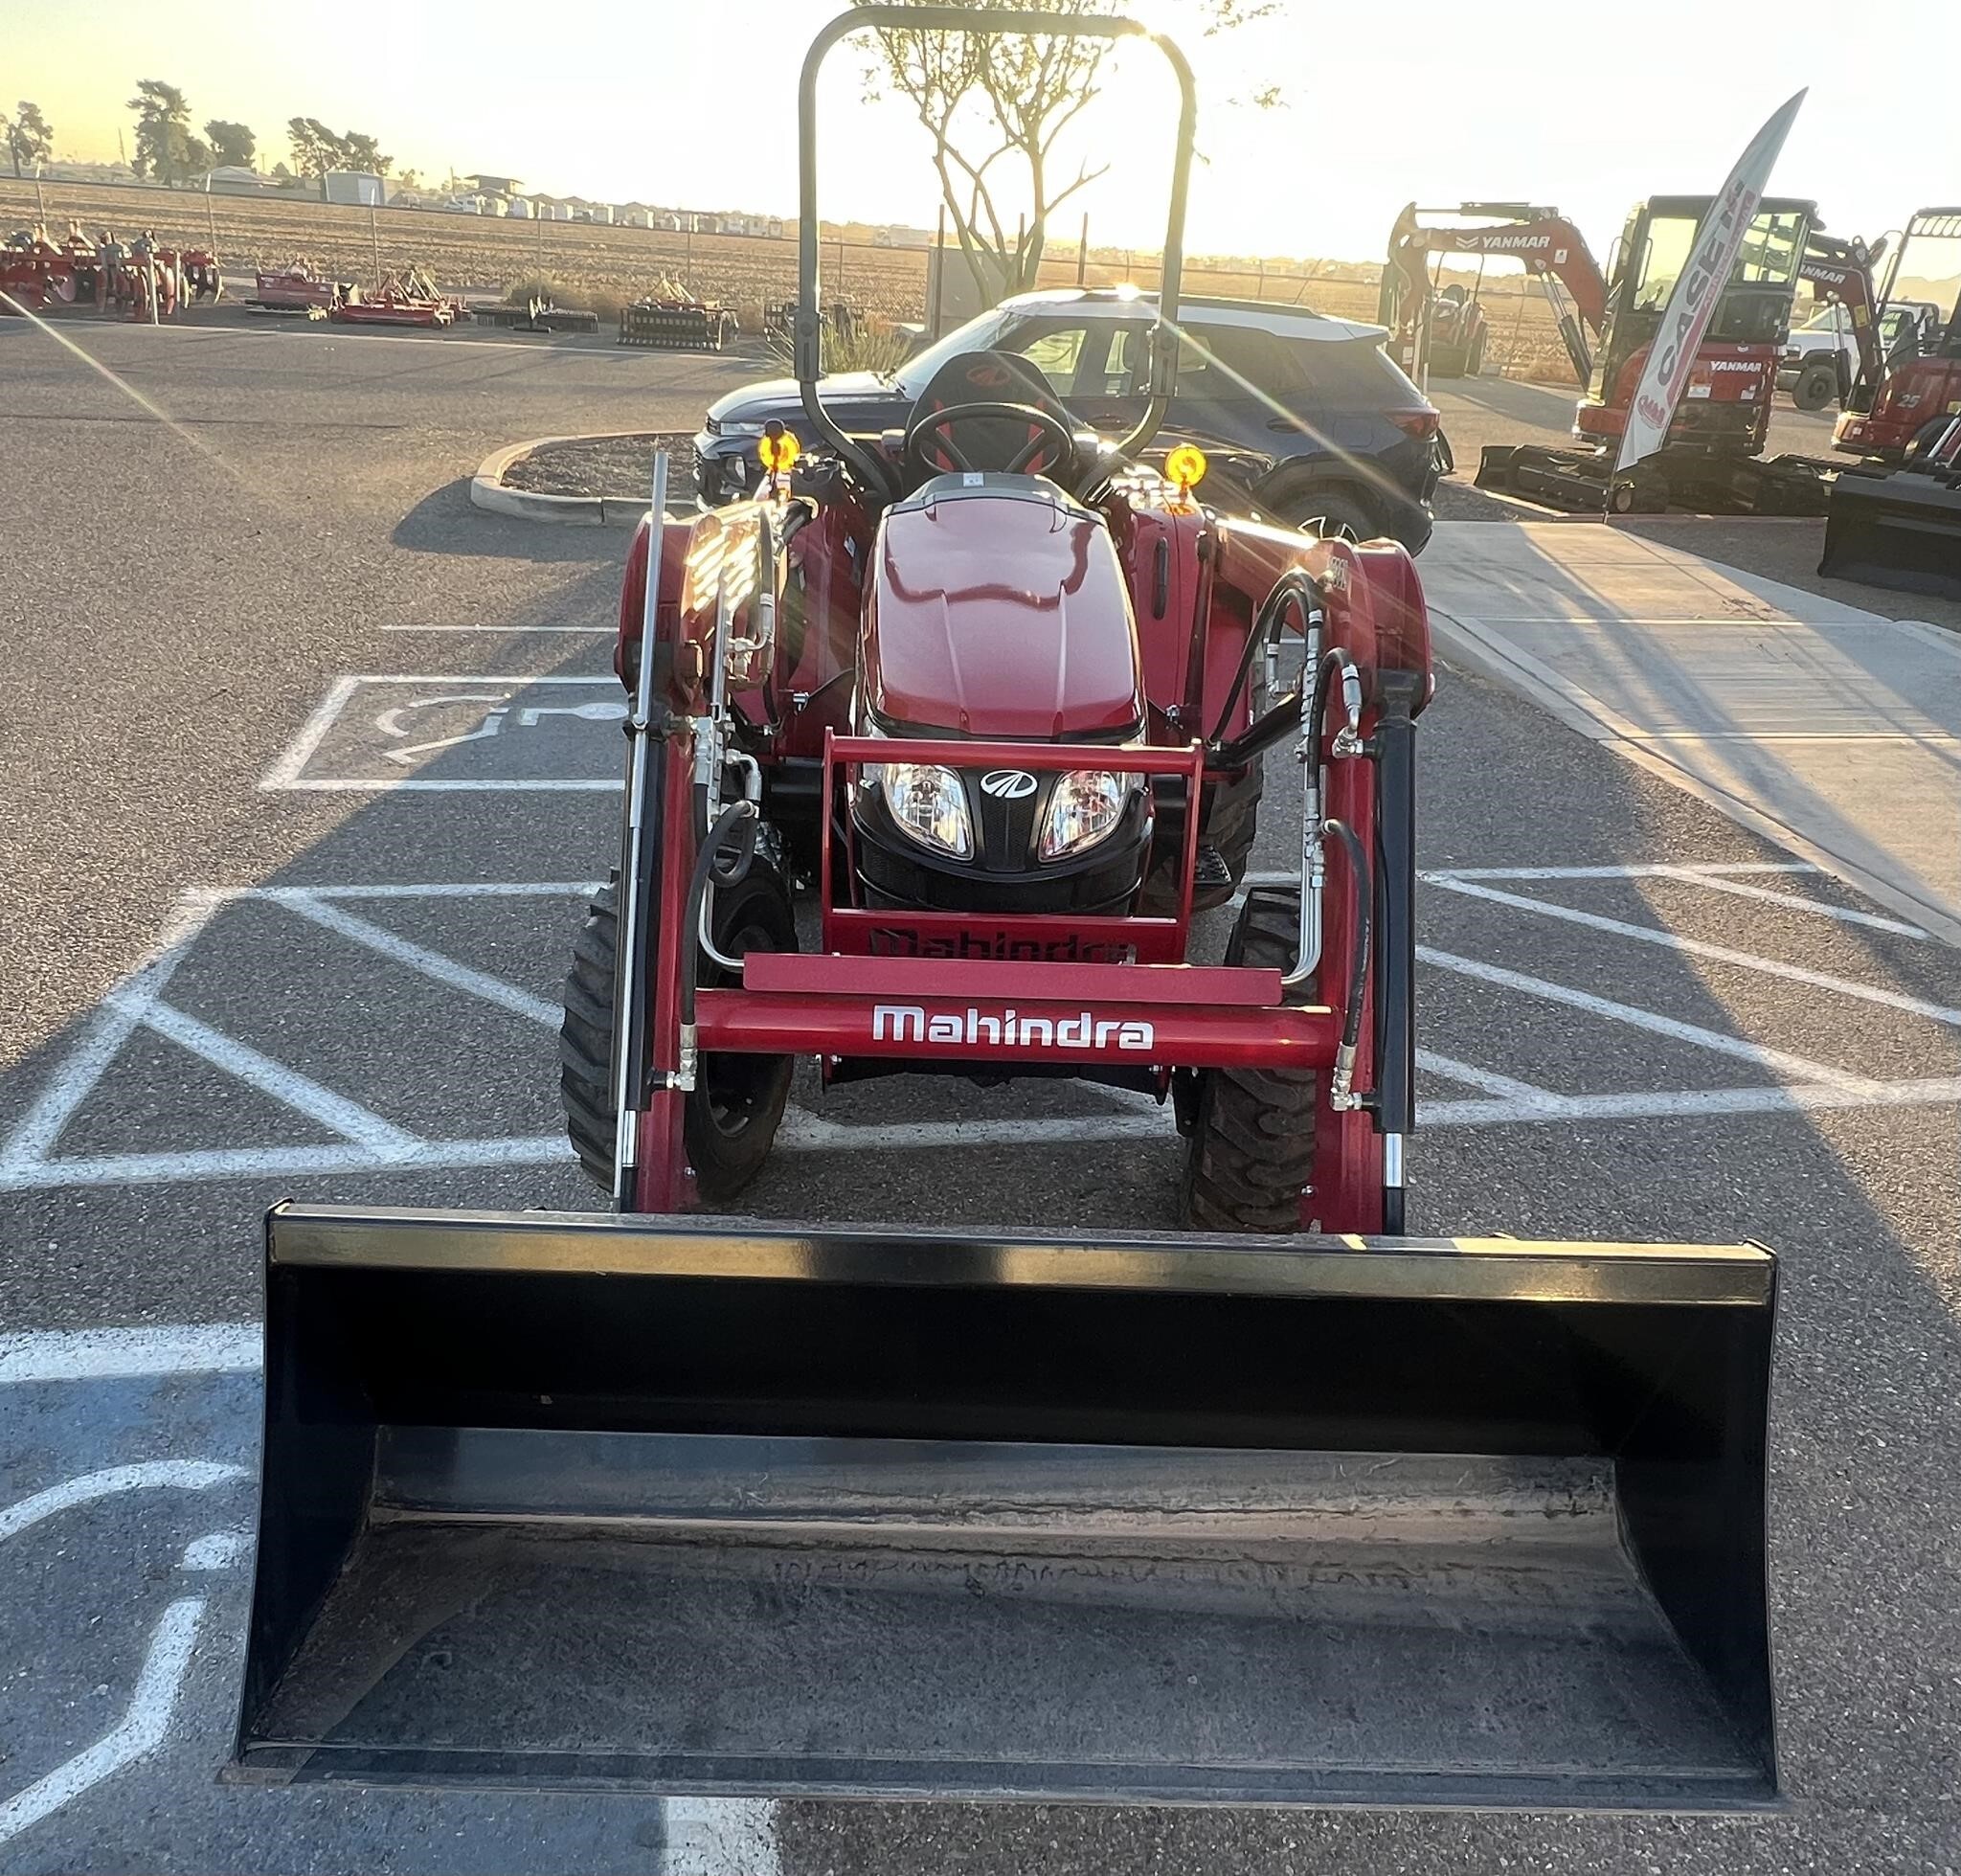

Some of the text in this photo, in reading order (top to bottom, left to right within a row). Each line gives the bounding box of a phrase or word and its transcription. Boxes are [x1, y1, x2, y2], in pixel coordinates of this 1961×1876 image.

[1481, 235, 1551, 249] YANMAR
[1657, 235, 1724, 387] CASE
[1709, 360, 1763, 373] YANMAR
[1897, 394, 1922, 408] 25
[872, 1005, 1154, 1051] Mahindra
